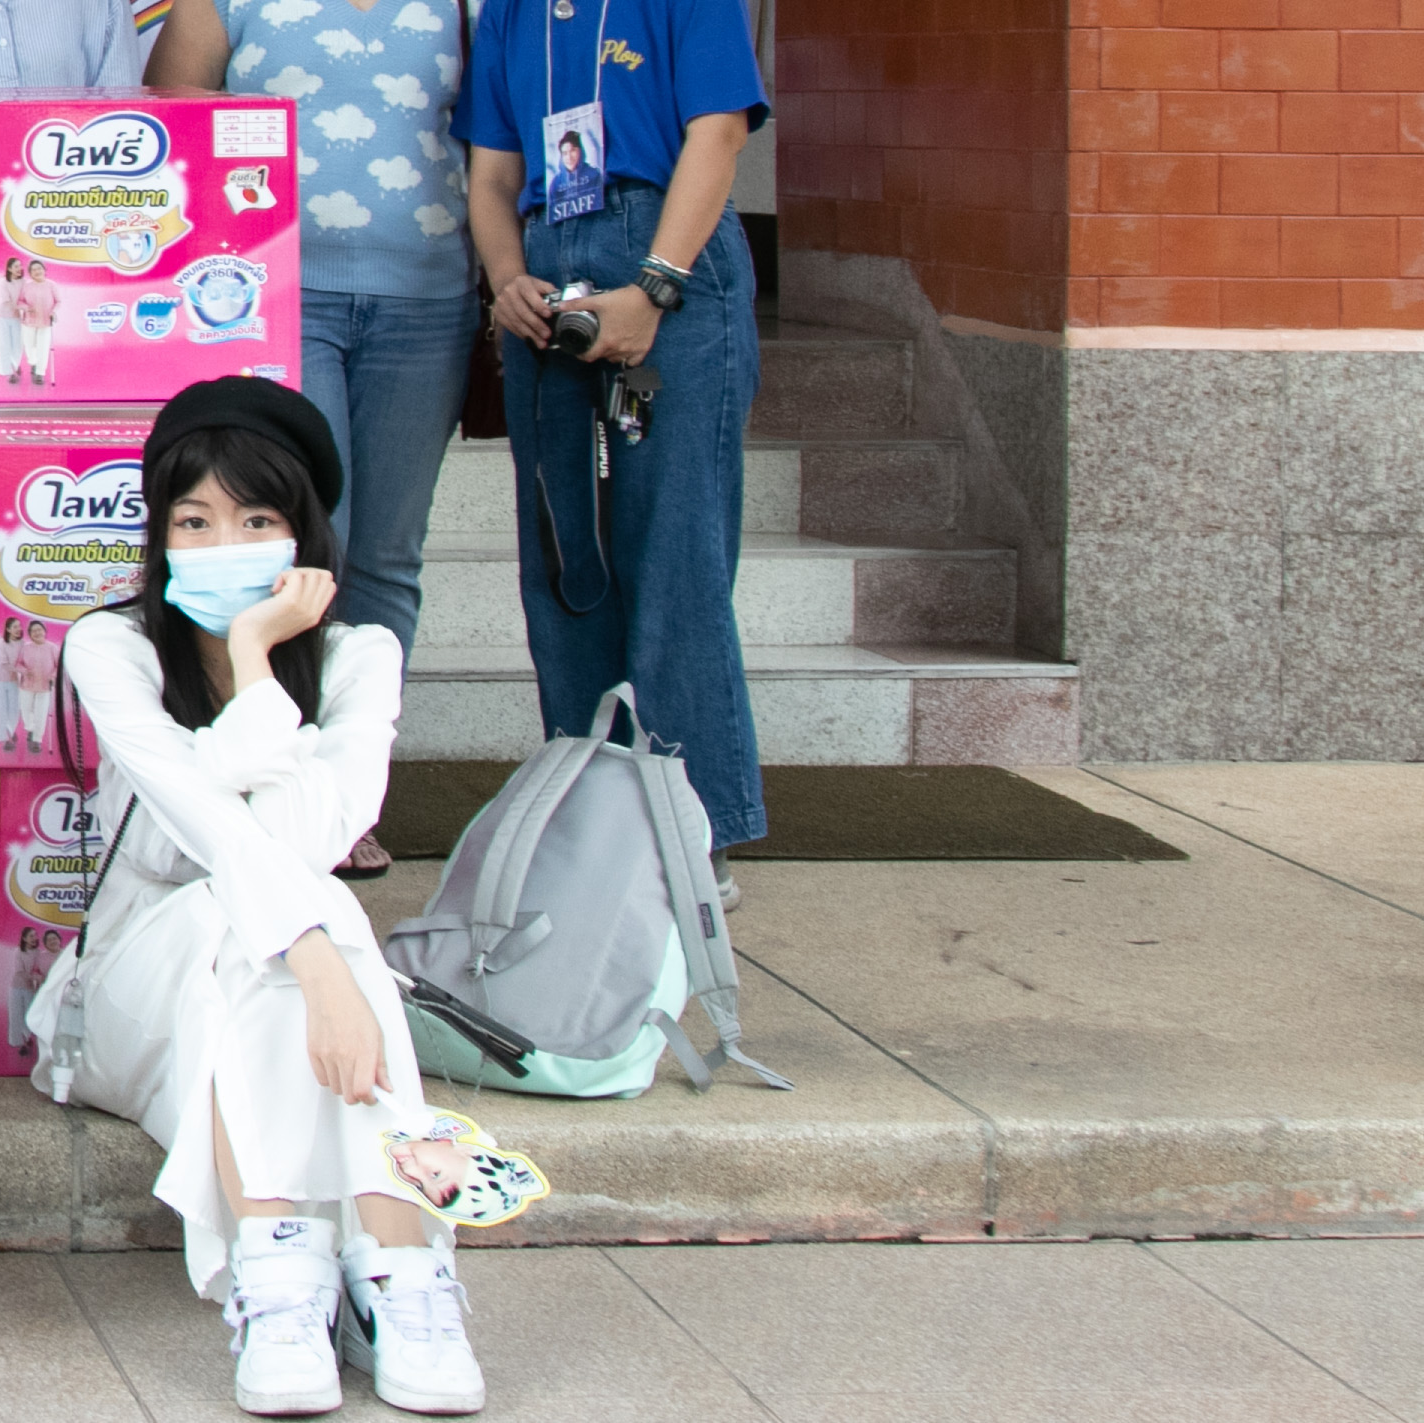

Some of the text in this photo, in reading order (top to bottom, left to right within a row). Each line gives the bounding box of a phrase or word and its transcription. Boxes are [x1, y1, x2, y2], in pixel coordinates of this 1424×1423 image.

[600, 39, 644, 71] Ploy
[257, 170, 265, 187] 1
[25, 185, 168, 208] กางเกงซึมซับมาก
[553, 193, 595, 221] STAFF
[129, 213, 141, 227] 2
[33, 222, 89, 236] สวมง่าย
[145, 319, 155, 332] 6
[597, 421, 610, 478] OLYMPUS
[17, 540, 146, 564] กางเกงซึมซับม
[25, 576, 86, 593] สวมง่าย
[280, 1221, 304, 1233] NIKE
